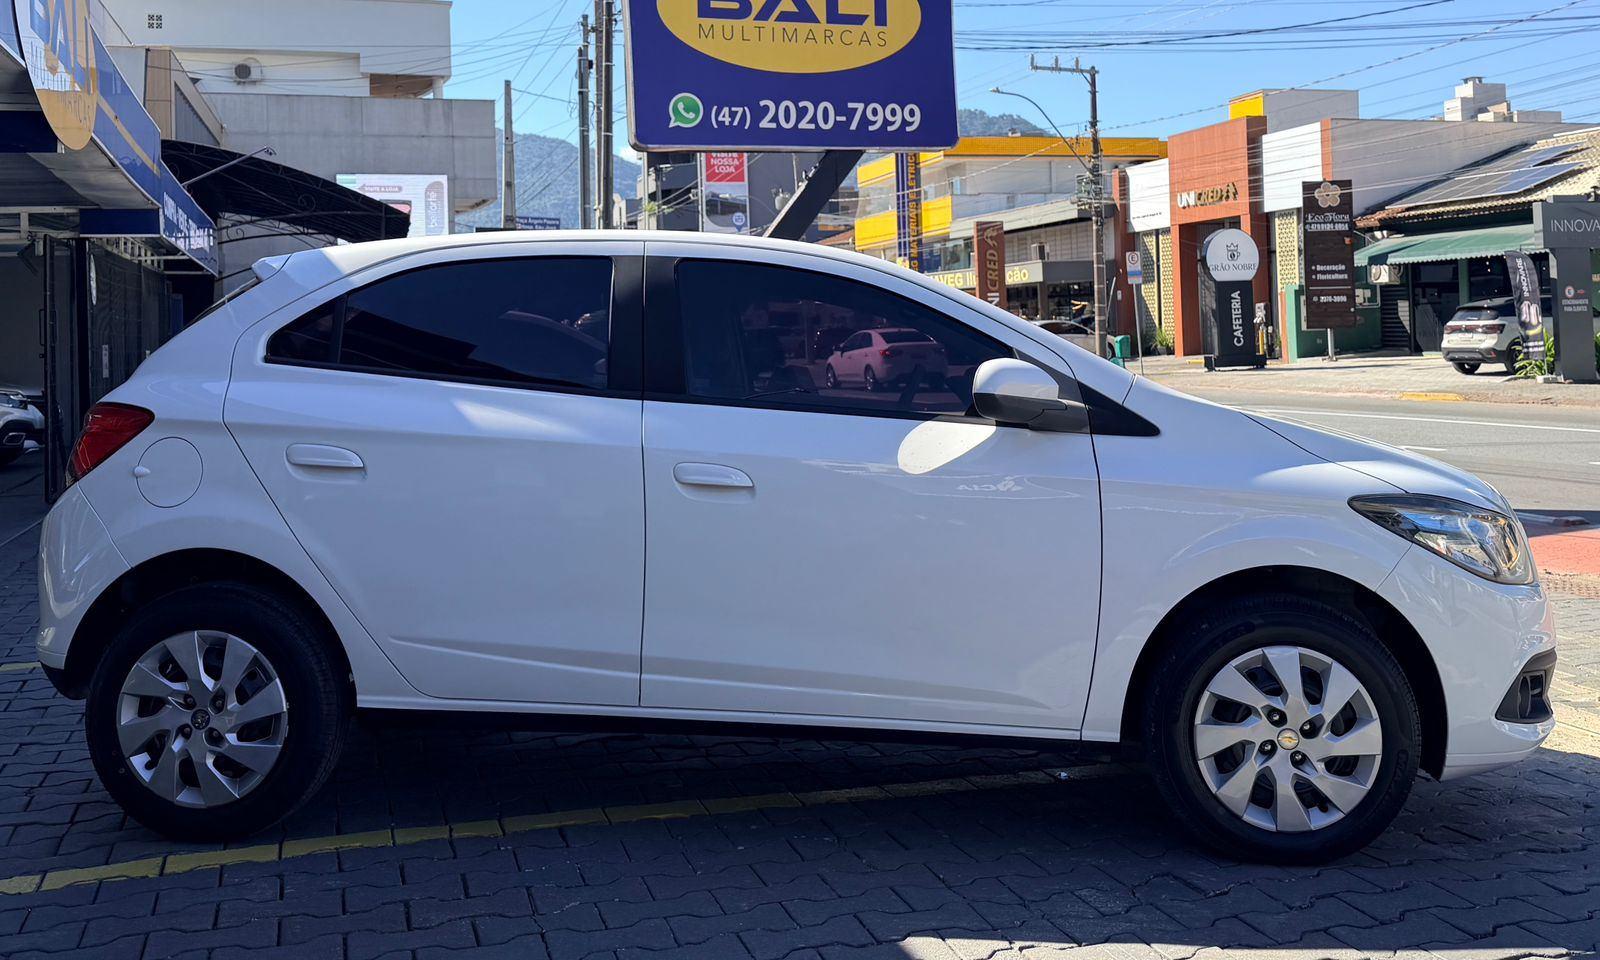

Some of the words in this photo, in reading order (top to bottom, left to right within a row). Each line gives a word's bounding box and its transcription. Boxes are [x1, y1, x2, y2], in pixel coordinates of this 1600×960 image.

[698, 23, 888, 47] MULTIMARCAS
[710, 105, 752, 130] (47)
[759, 98, 922, 132] 2020-7999
[710, 158, 740, 166] NOSSA
[1177, 187, 1222, 208] UNICRED
[909, 201, 919, 258] MATERIAIS
[1230, 290, 1244, 347] CAFETERIA
